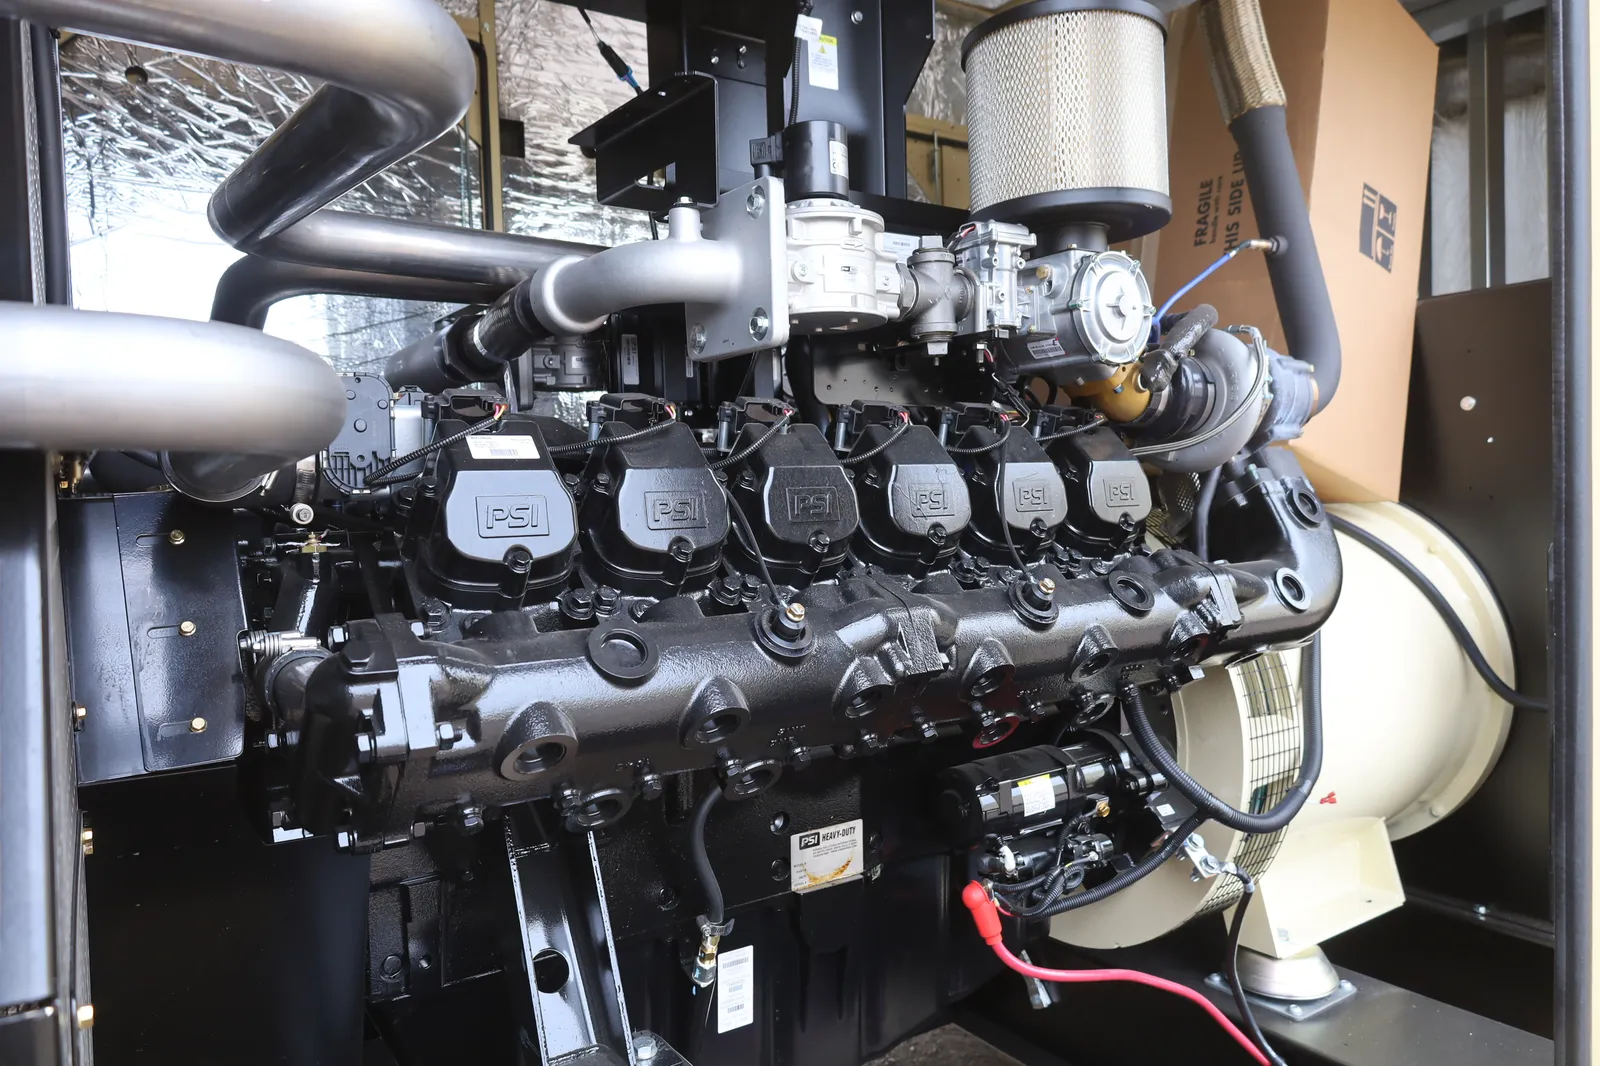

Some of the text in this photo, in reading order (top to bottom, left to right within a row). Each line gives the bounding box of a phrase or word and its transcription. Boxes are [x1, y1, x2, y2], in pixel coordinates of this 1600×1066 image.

[1228, 178, 1244, 216] SIDE
[1194, 178, 1213, 247] FRAGILE
[1224, 221, 1240, 256] HIS
[916, 489, 950, 511] PSI
[1018, 486, 1047, 506] PSI
[1109, 482, 1135, 502] PSI
[486, 503, 540, 529] PSI
[653, 498, 699, 523] PSI
[794, 493, 832, 516] PSI
[800, 826, 857, 848] PSI HEAVY-DUTY
